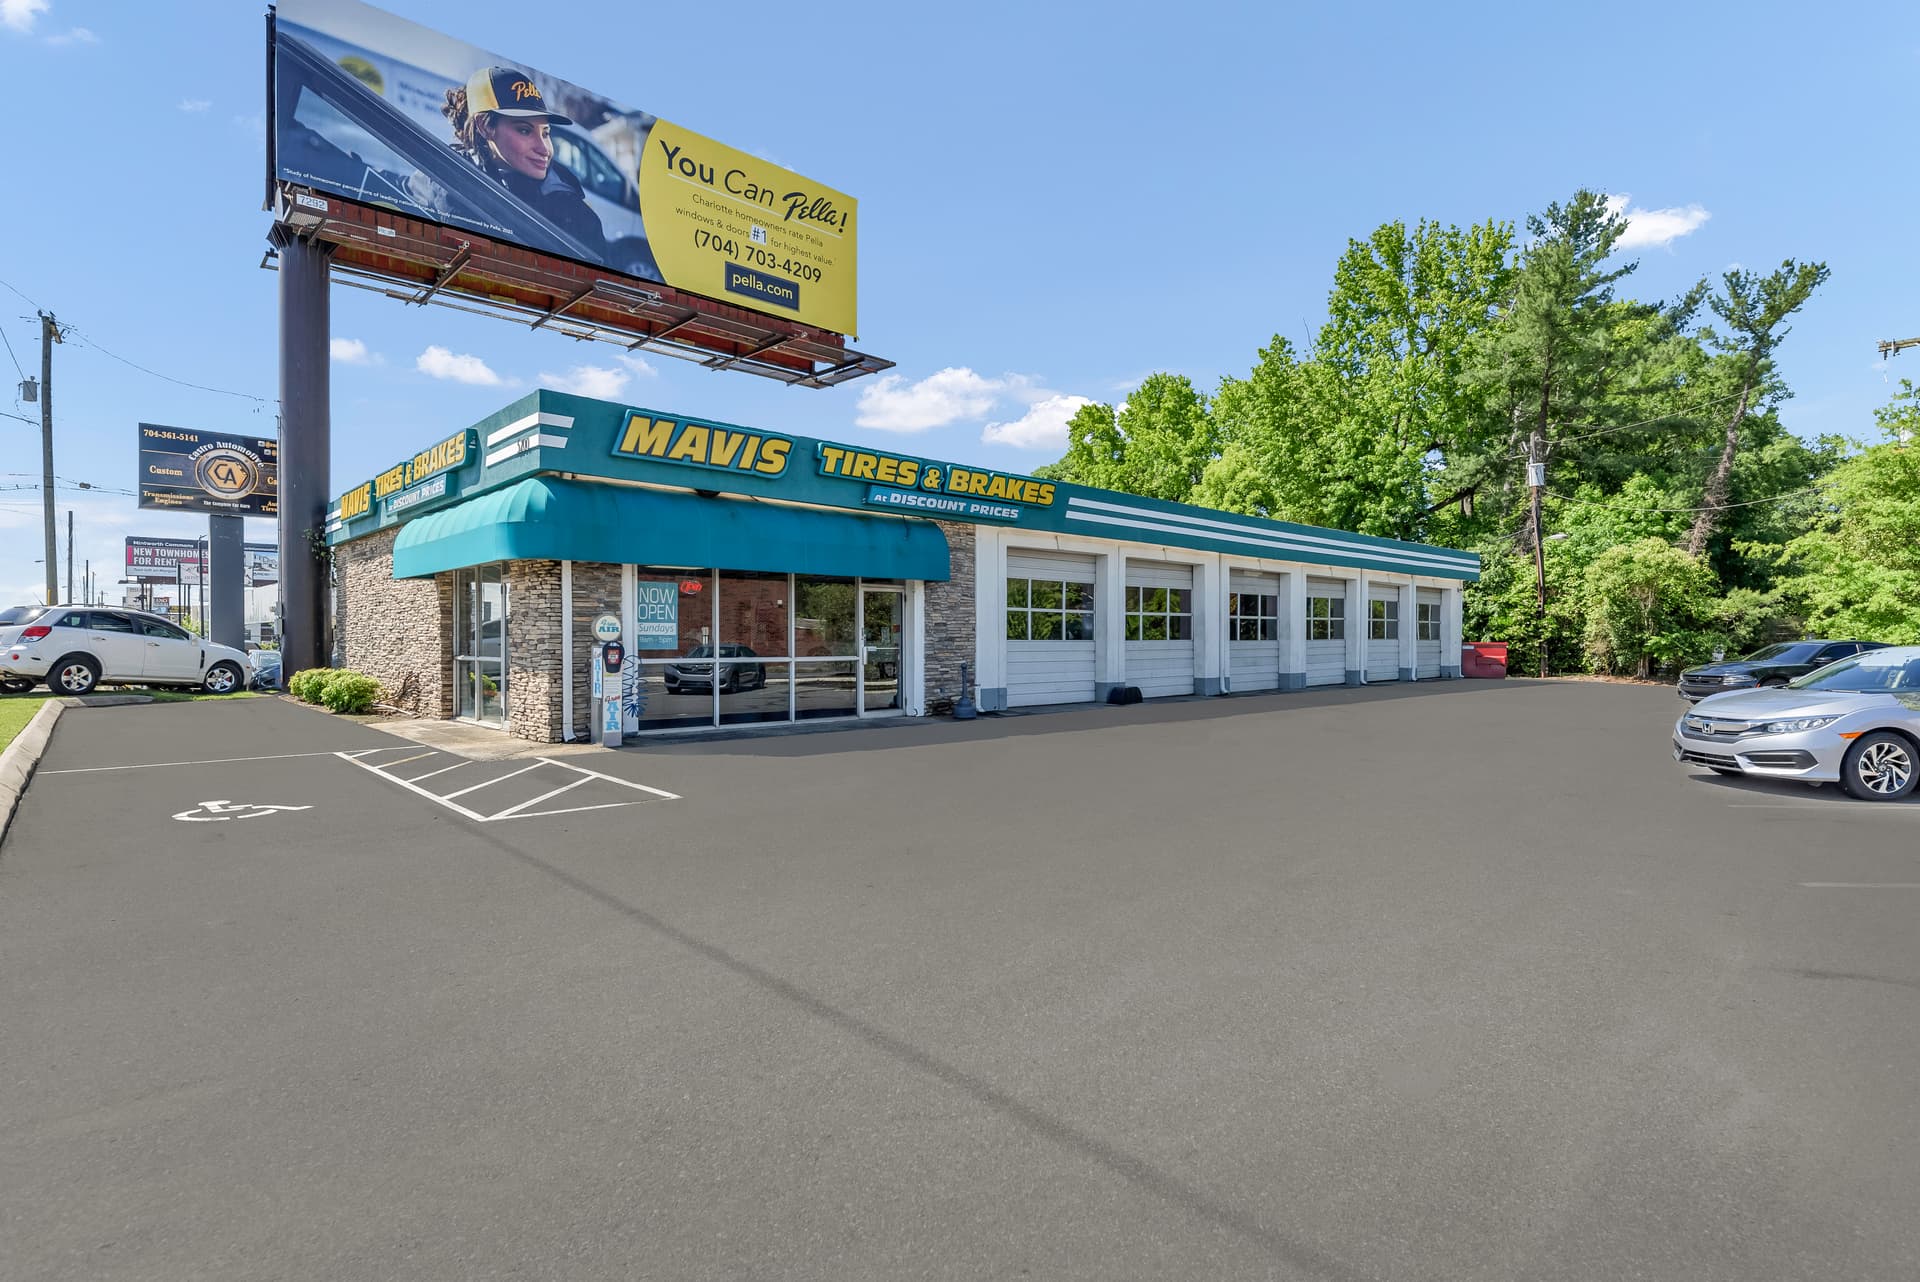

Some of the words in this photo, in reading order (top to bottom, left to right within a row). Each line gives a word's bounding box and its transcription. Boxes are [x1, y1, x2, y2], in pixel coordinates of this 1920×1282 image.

[660, 139, 714, 185] You
[724, 169, 774, 207] Can
[782, 191, 848, 233] Pella!
[310, 174, 341, 187] homeowner
[380, 194, 398, 204] leading
[483, 221, 490, 229] by
[692, 193, 733, 216] Charlotte
[735, 207, 786, 234] homeowners
[788, 228, 804, 240] rate
[805, 233, 823, 248] Pella
[675, 206, 714, 226] windows
[717, 218, 724, 228] &
[726, 222, 750, 238] doors
[752, 227, 767, 244] #1
[770, 237, 782, 248] for
[783, 242, 811, 260] highest
[694, 229, 739, 260] (704)
[745, 245, 822, 283] 703-4209
[732, 272, 793, 300] pella.com
[143, 429, 199, 442] 704-361-5141
[188, 443, 214, 461] Castro
[216, 441, 264, 468] Automotive
[618, 415, 793, 474] MAVIS
[821, 446, 920, 487] TIRES
[922, 465, 943, 490] &
[949, 469, 1057, 507] BRAKES
[149, 465, 183, 476] Custom
[214, 463, 237, 485] CA
[340, 482, 371, 521] MAVIS
[375, 464, 404, 498] TIRES
[405, 462, 413, 486] &
[413, 431, 466, 482] BRAKES
[143, 489, 194, 500] Transmissions
[155, 496, 182, 505] Engines
[421, 480, 444, 497] PRICES
[890, 492, 967, 514] DISCOUNT
[970, 503, 1018, 519] PRICES
[133, 547, 153, 557] NEW
[133, 556, 152, 566] FOR
[155, 557, 177, 566] RENT
[639, 587, 675, 603] NOW
[638, 603, 675, 620] OPEN
[639, 623, 674, 635] Sundays
[606, 702, 620, 731] AIR
